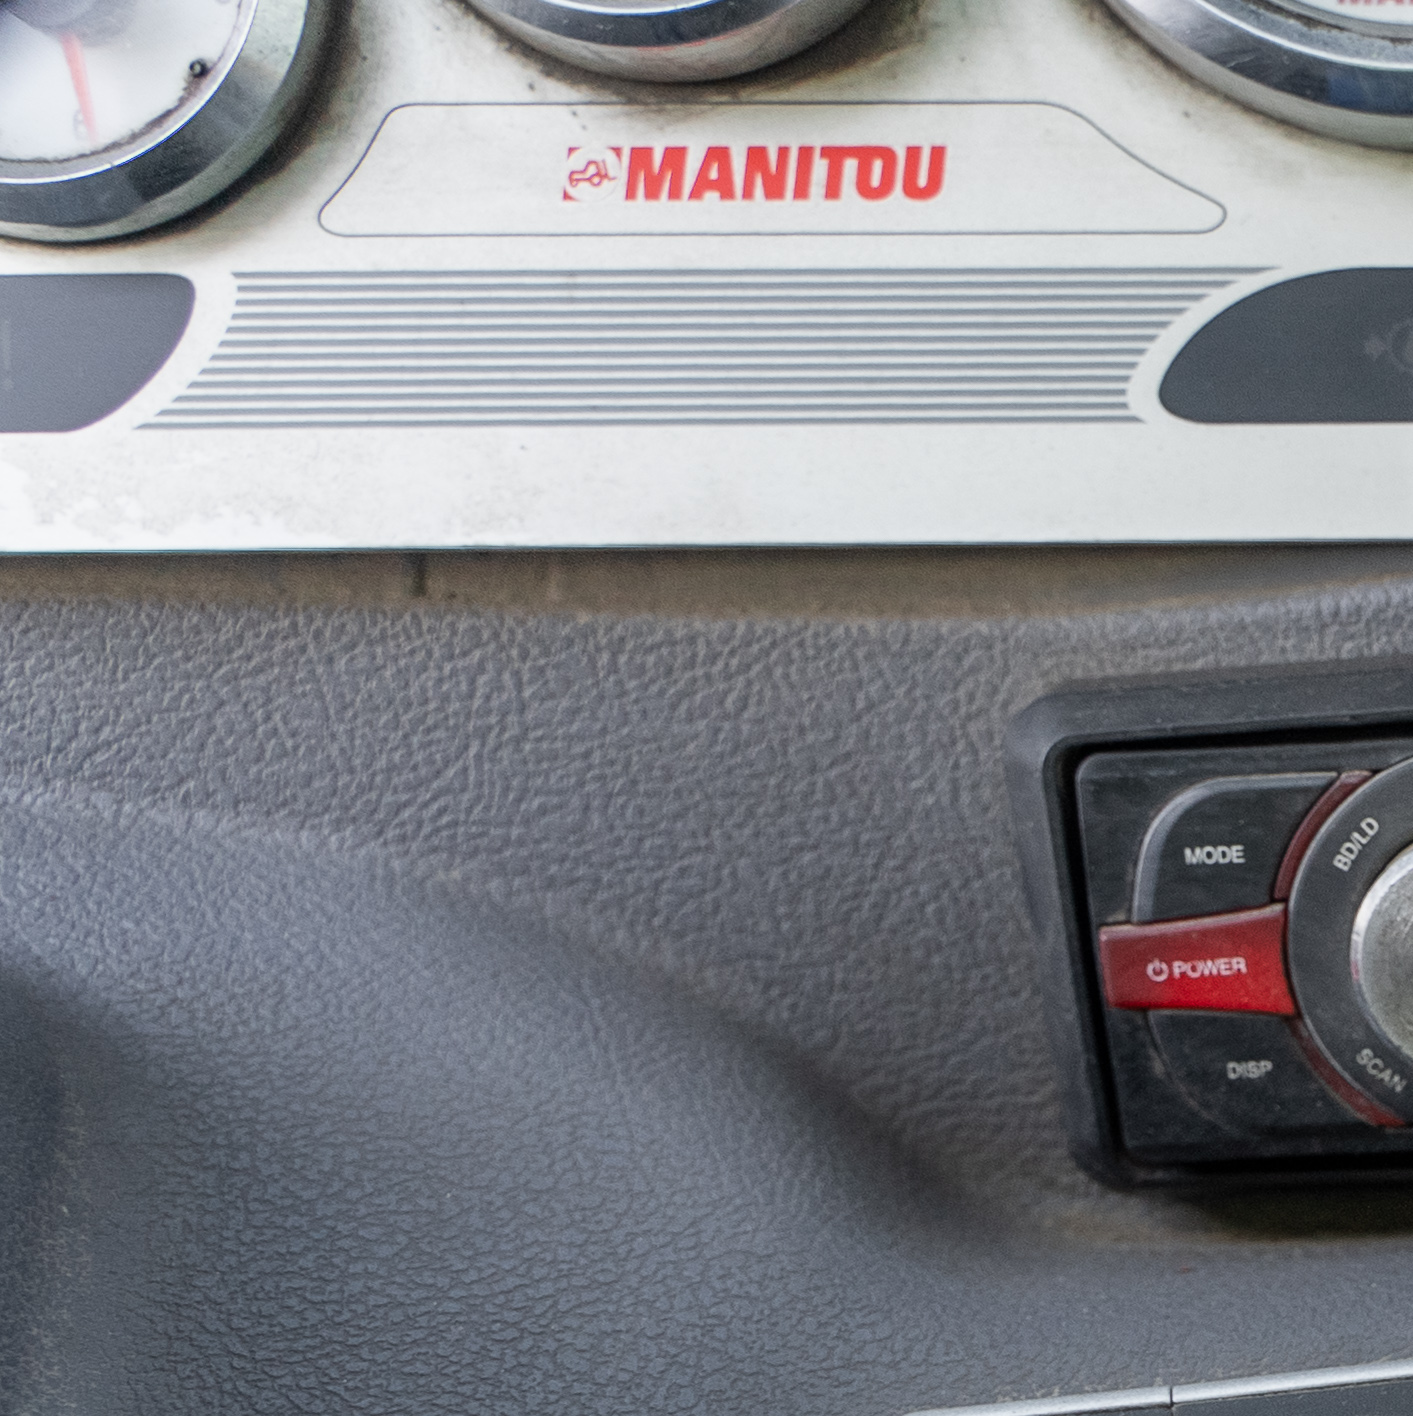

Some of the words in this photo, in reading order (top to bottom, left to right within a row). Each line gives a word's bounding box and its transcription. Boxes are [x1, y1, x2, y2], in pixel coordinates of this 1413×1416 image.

[624, 145, 948, 201] MANITOU
[1184, 845, 1246, 866] MODE
[1332, 816, 1380, 872] BD/LD
[1171, 957, 1247, 978] POWER
[1226, 1060, 1273, 1081] DISP
[1355, 1047, 1407, 1095] SCAN
